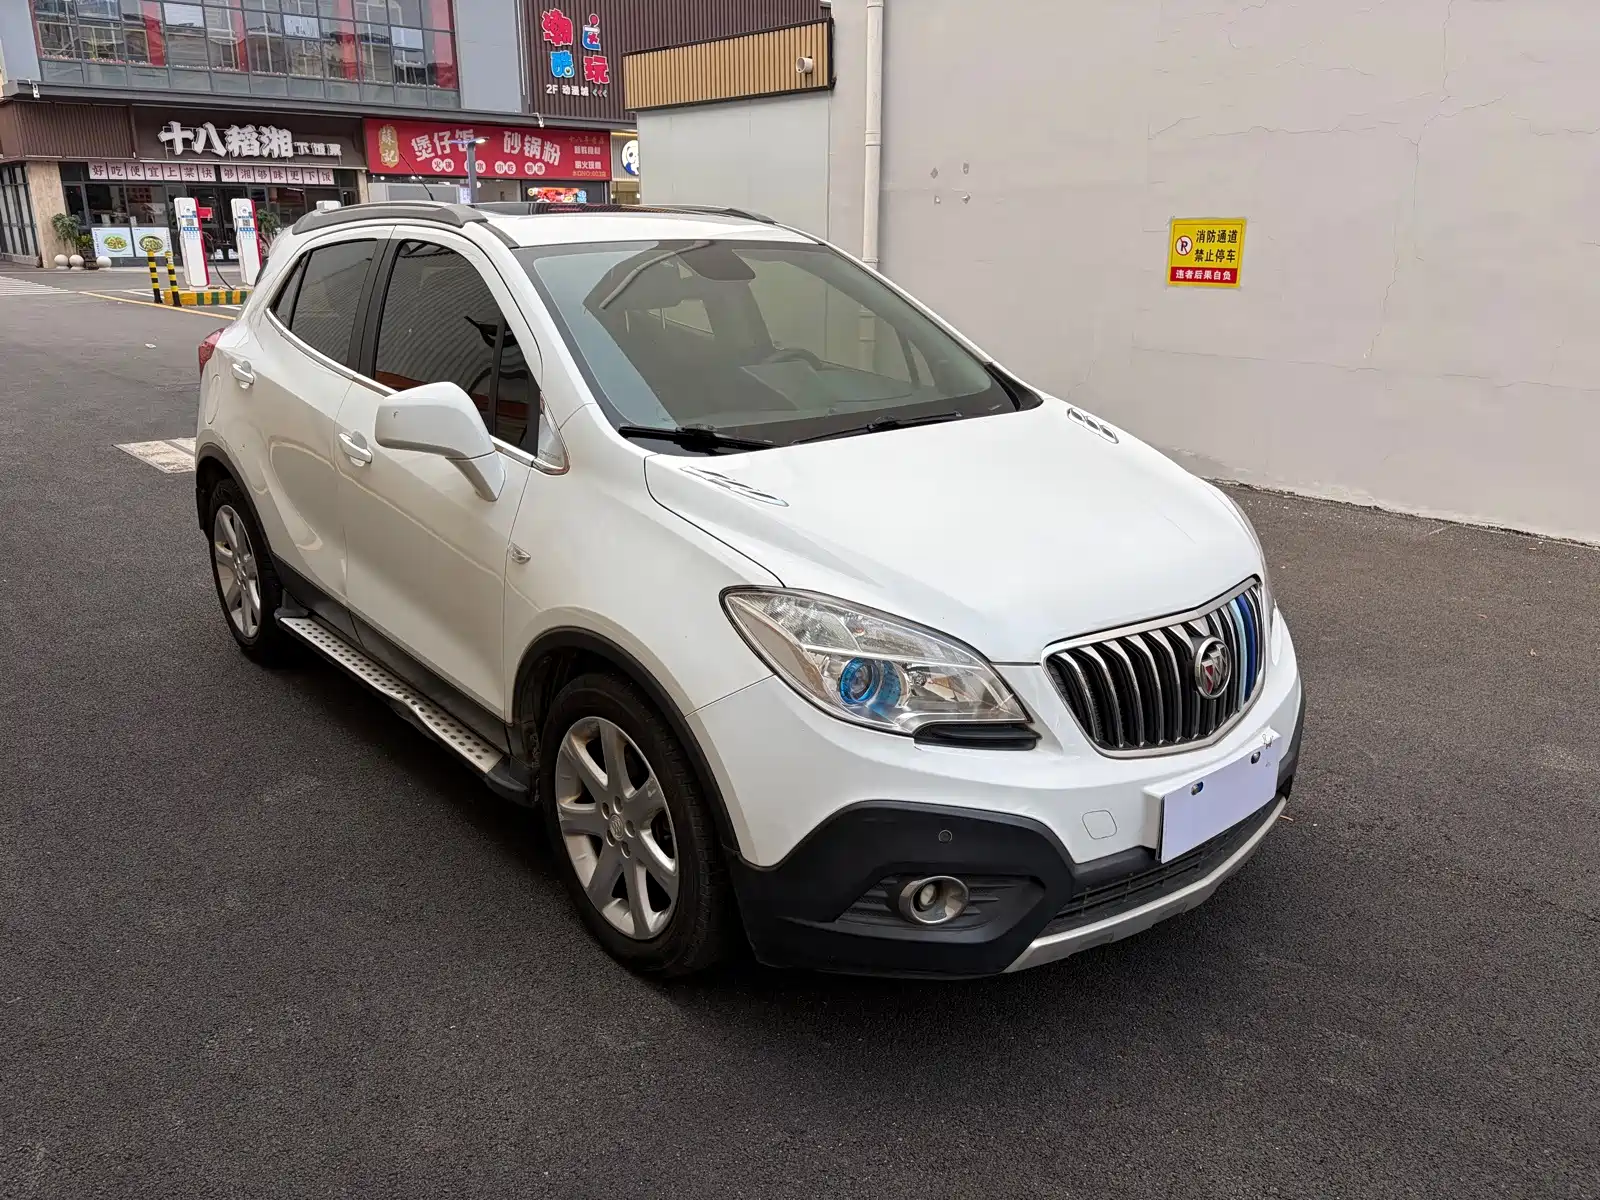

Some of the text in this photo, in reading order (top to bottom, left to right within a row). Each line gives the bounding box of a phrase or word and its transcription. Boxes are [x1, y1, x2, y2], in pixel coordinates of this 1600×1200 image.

[546, 84, 558, 94] 2F
[503, 130, 561, 167] 砂锅粉
[91, 164, 332, 182] 好吃便宜上菜快 够湘够味更下饭
[433, 160, 453, 171] 火锅
[1195, 229, 1238, 244] 消防通道
[1194, 248, 1236, 263] 禁止停车
[1175, 269, 1232, 281] 违者后果自负
